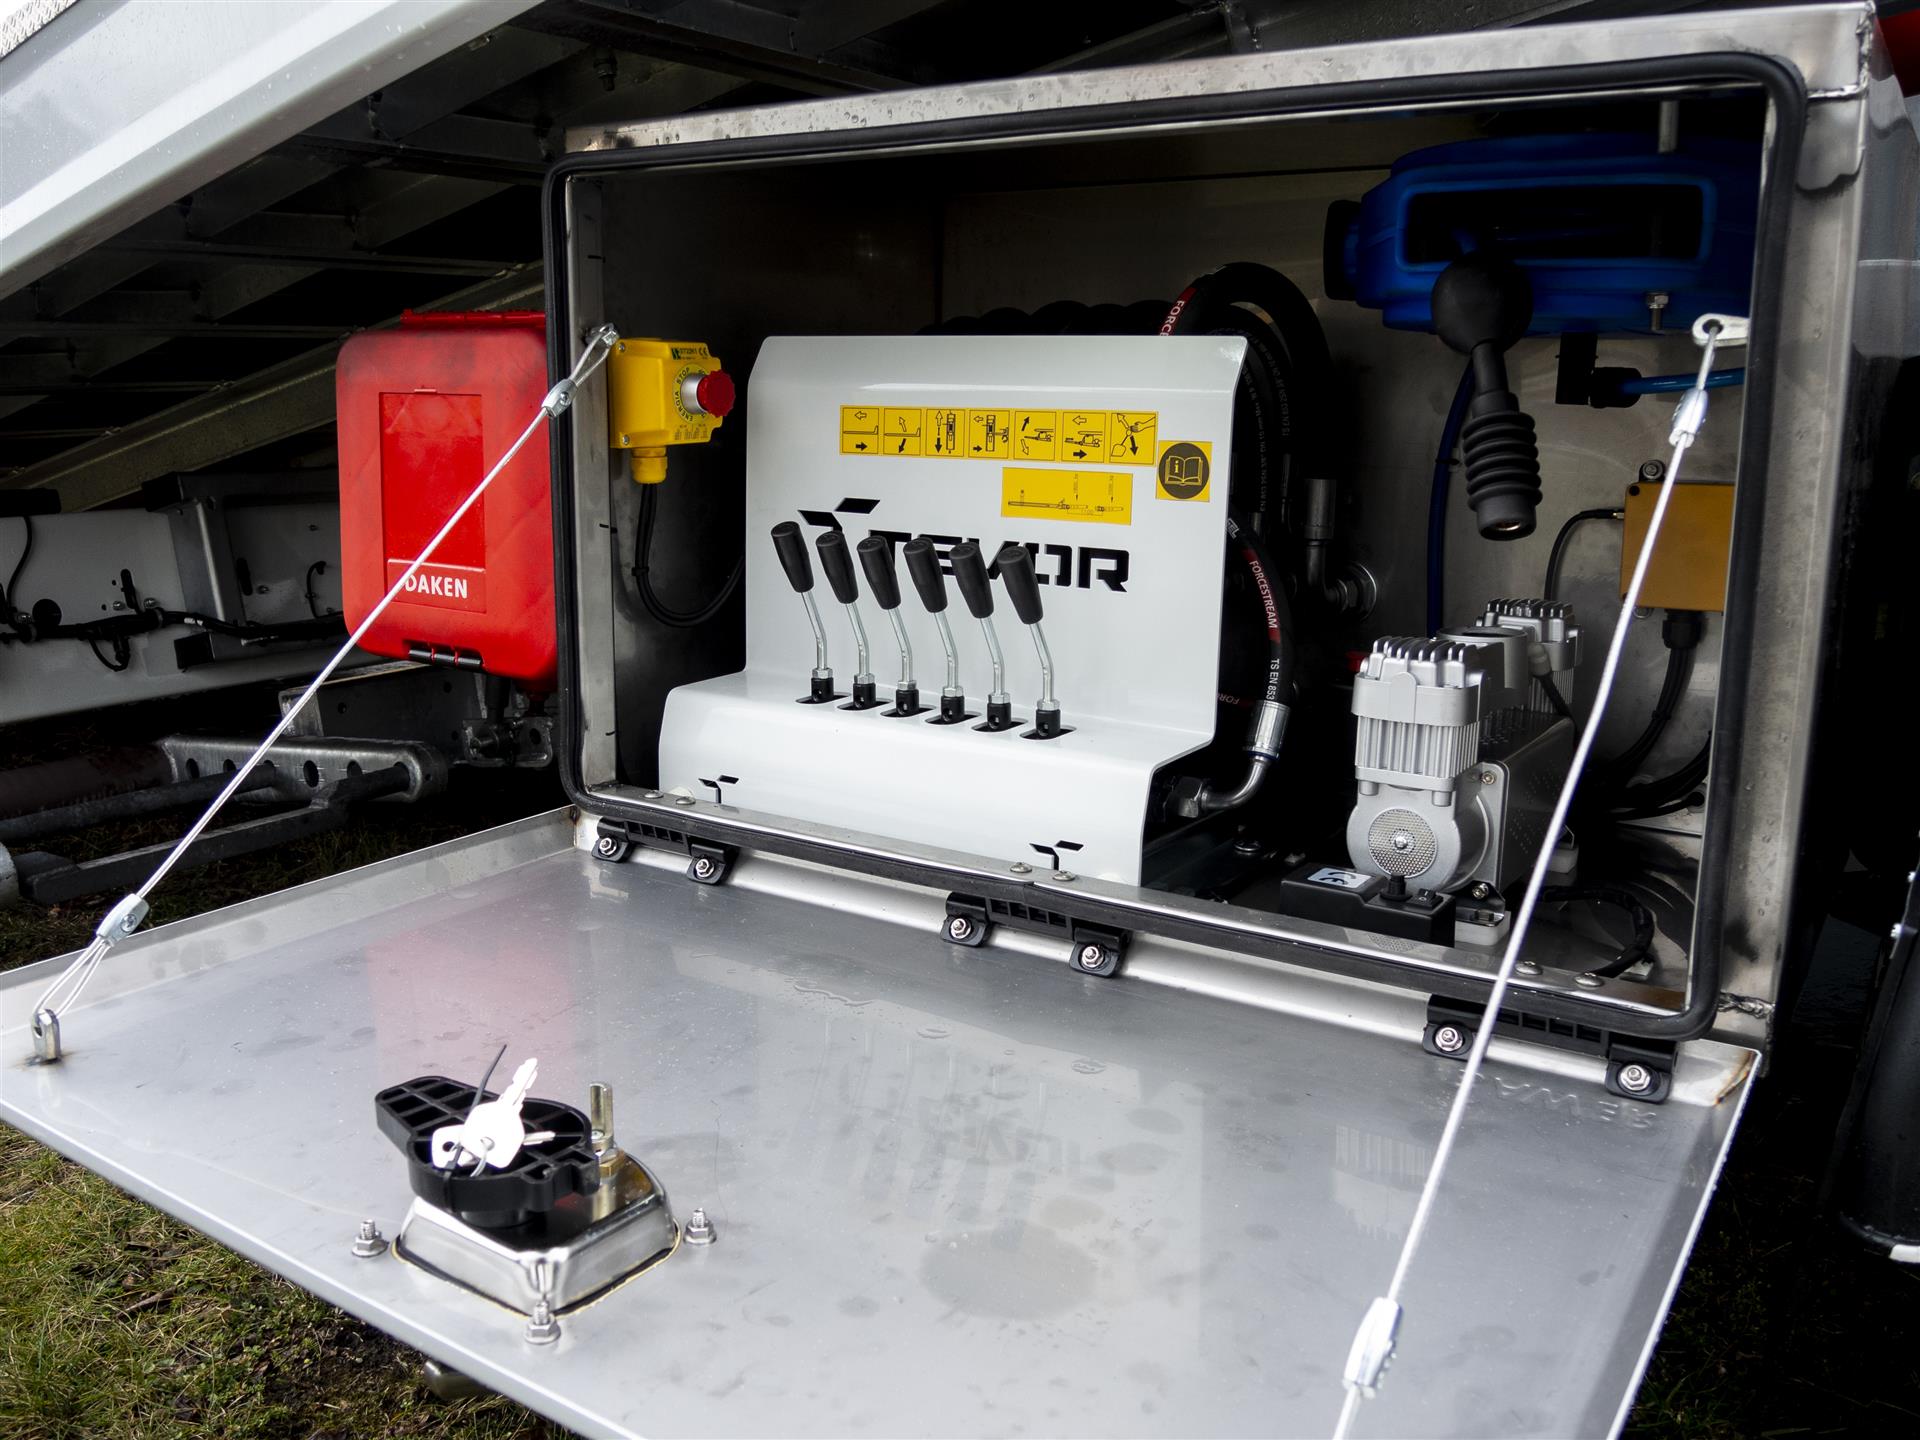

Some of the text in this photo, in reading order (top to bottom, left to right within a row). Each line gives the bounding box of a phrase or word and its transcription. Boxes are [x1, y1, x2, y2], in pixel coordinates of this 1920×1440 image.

[676, 367, 690, 384] STOP
[674, 391, 693, 422] ENERGIA
[1249, 560, 1278, 628] FORCESTREAM
[1265, 658, 1280, 700] TS EN 853
[1217, 692, 1240, 705] FOR
